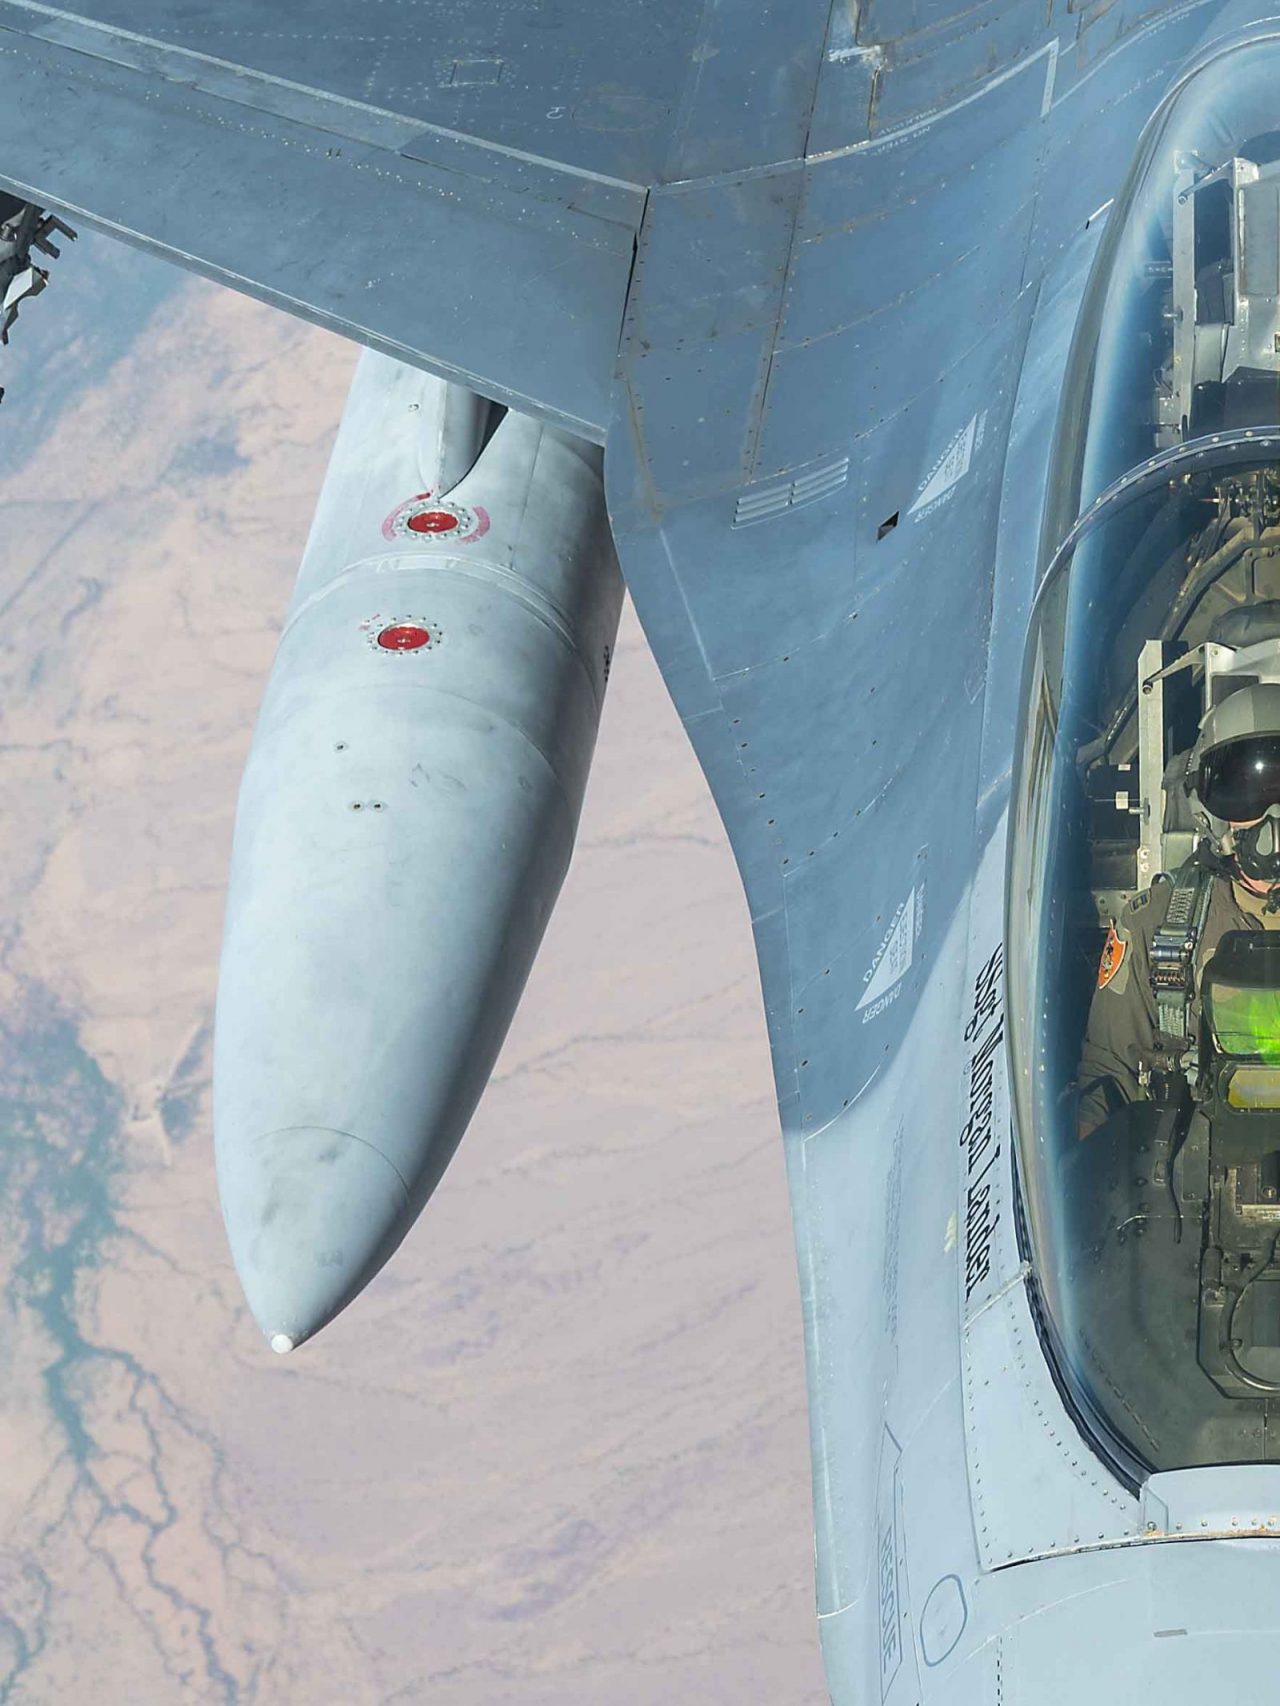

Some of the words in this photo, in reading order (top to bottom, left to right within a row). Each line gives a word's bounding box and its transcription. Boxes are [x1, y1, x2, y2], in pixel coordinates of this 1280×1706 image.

[964, 942, 1004, 1042] SSgt
[960, 1014, 1004, 1176] Morgan
[966, 1145, 1002, 1303] Lander
[880, 1525, 897, 1673] RESCUE
